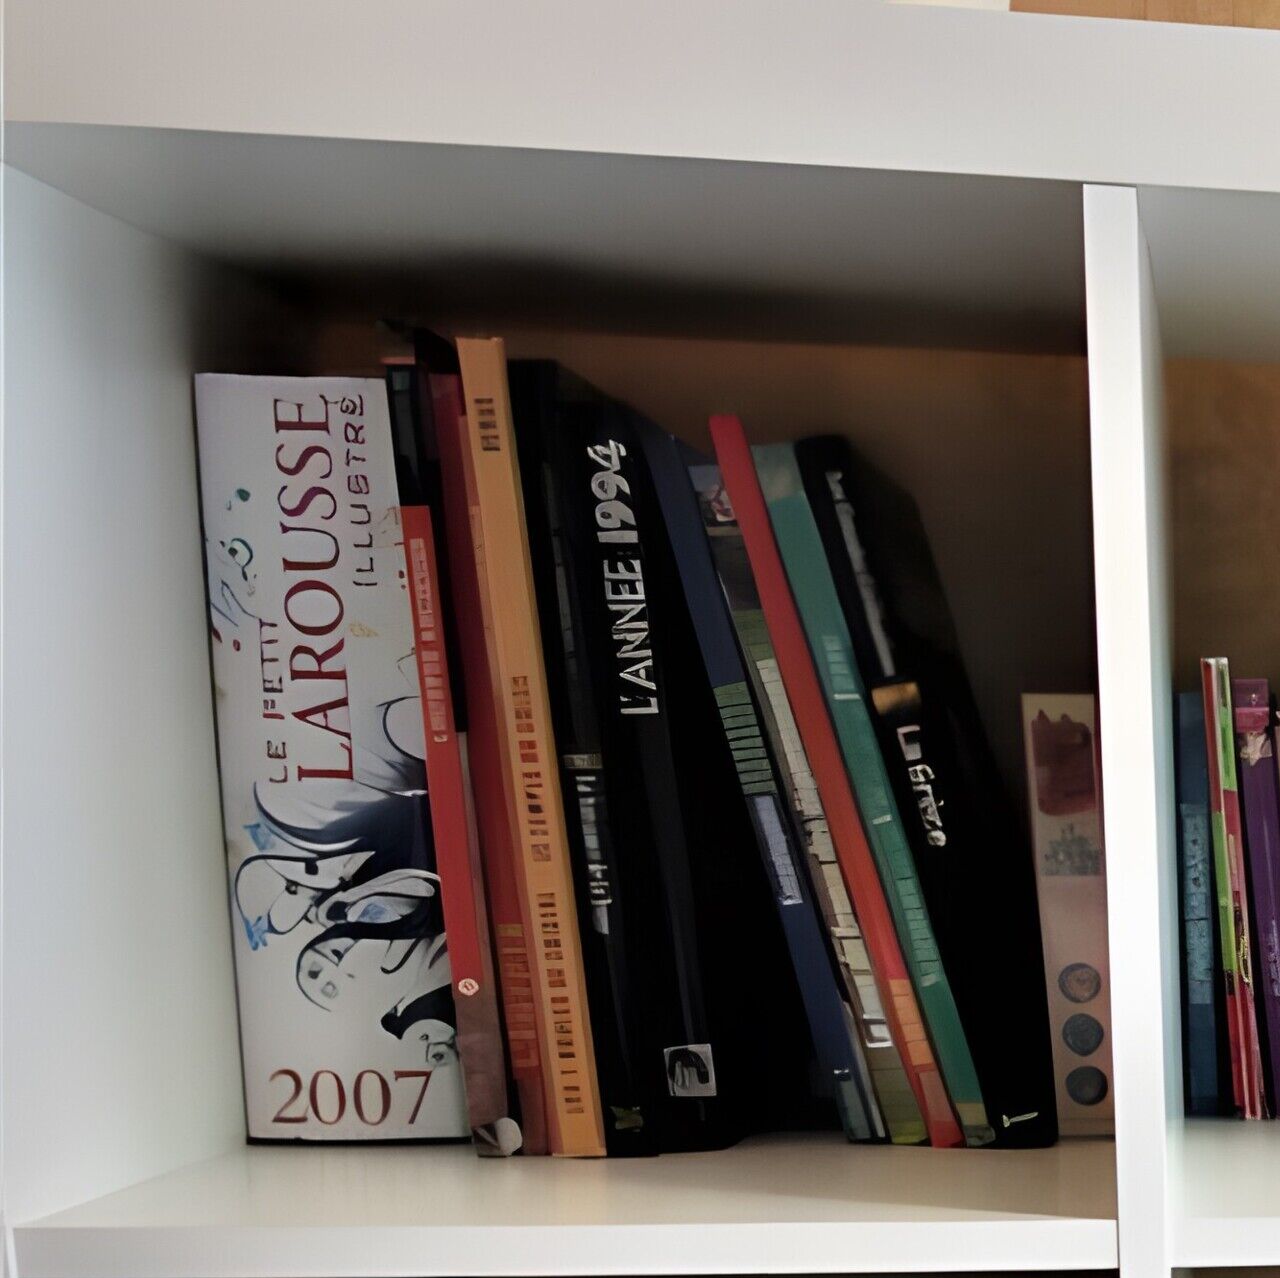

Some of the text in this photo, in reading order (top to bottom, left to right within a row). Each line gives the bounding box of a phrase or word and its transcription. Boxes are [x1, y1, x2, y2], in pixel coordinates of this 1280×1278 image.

[586, 438, 640, 545] 1994
[273, 393, 354, 782] LAROUSSE
[268, 1068, 438, 1129] 2007
